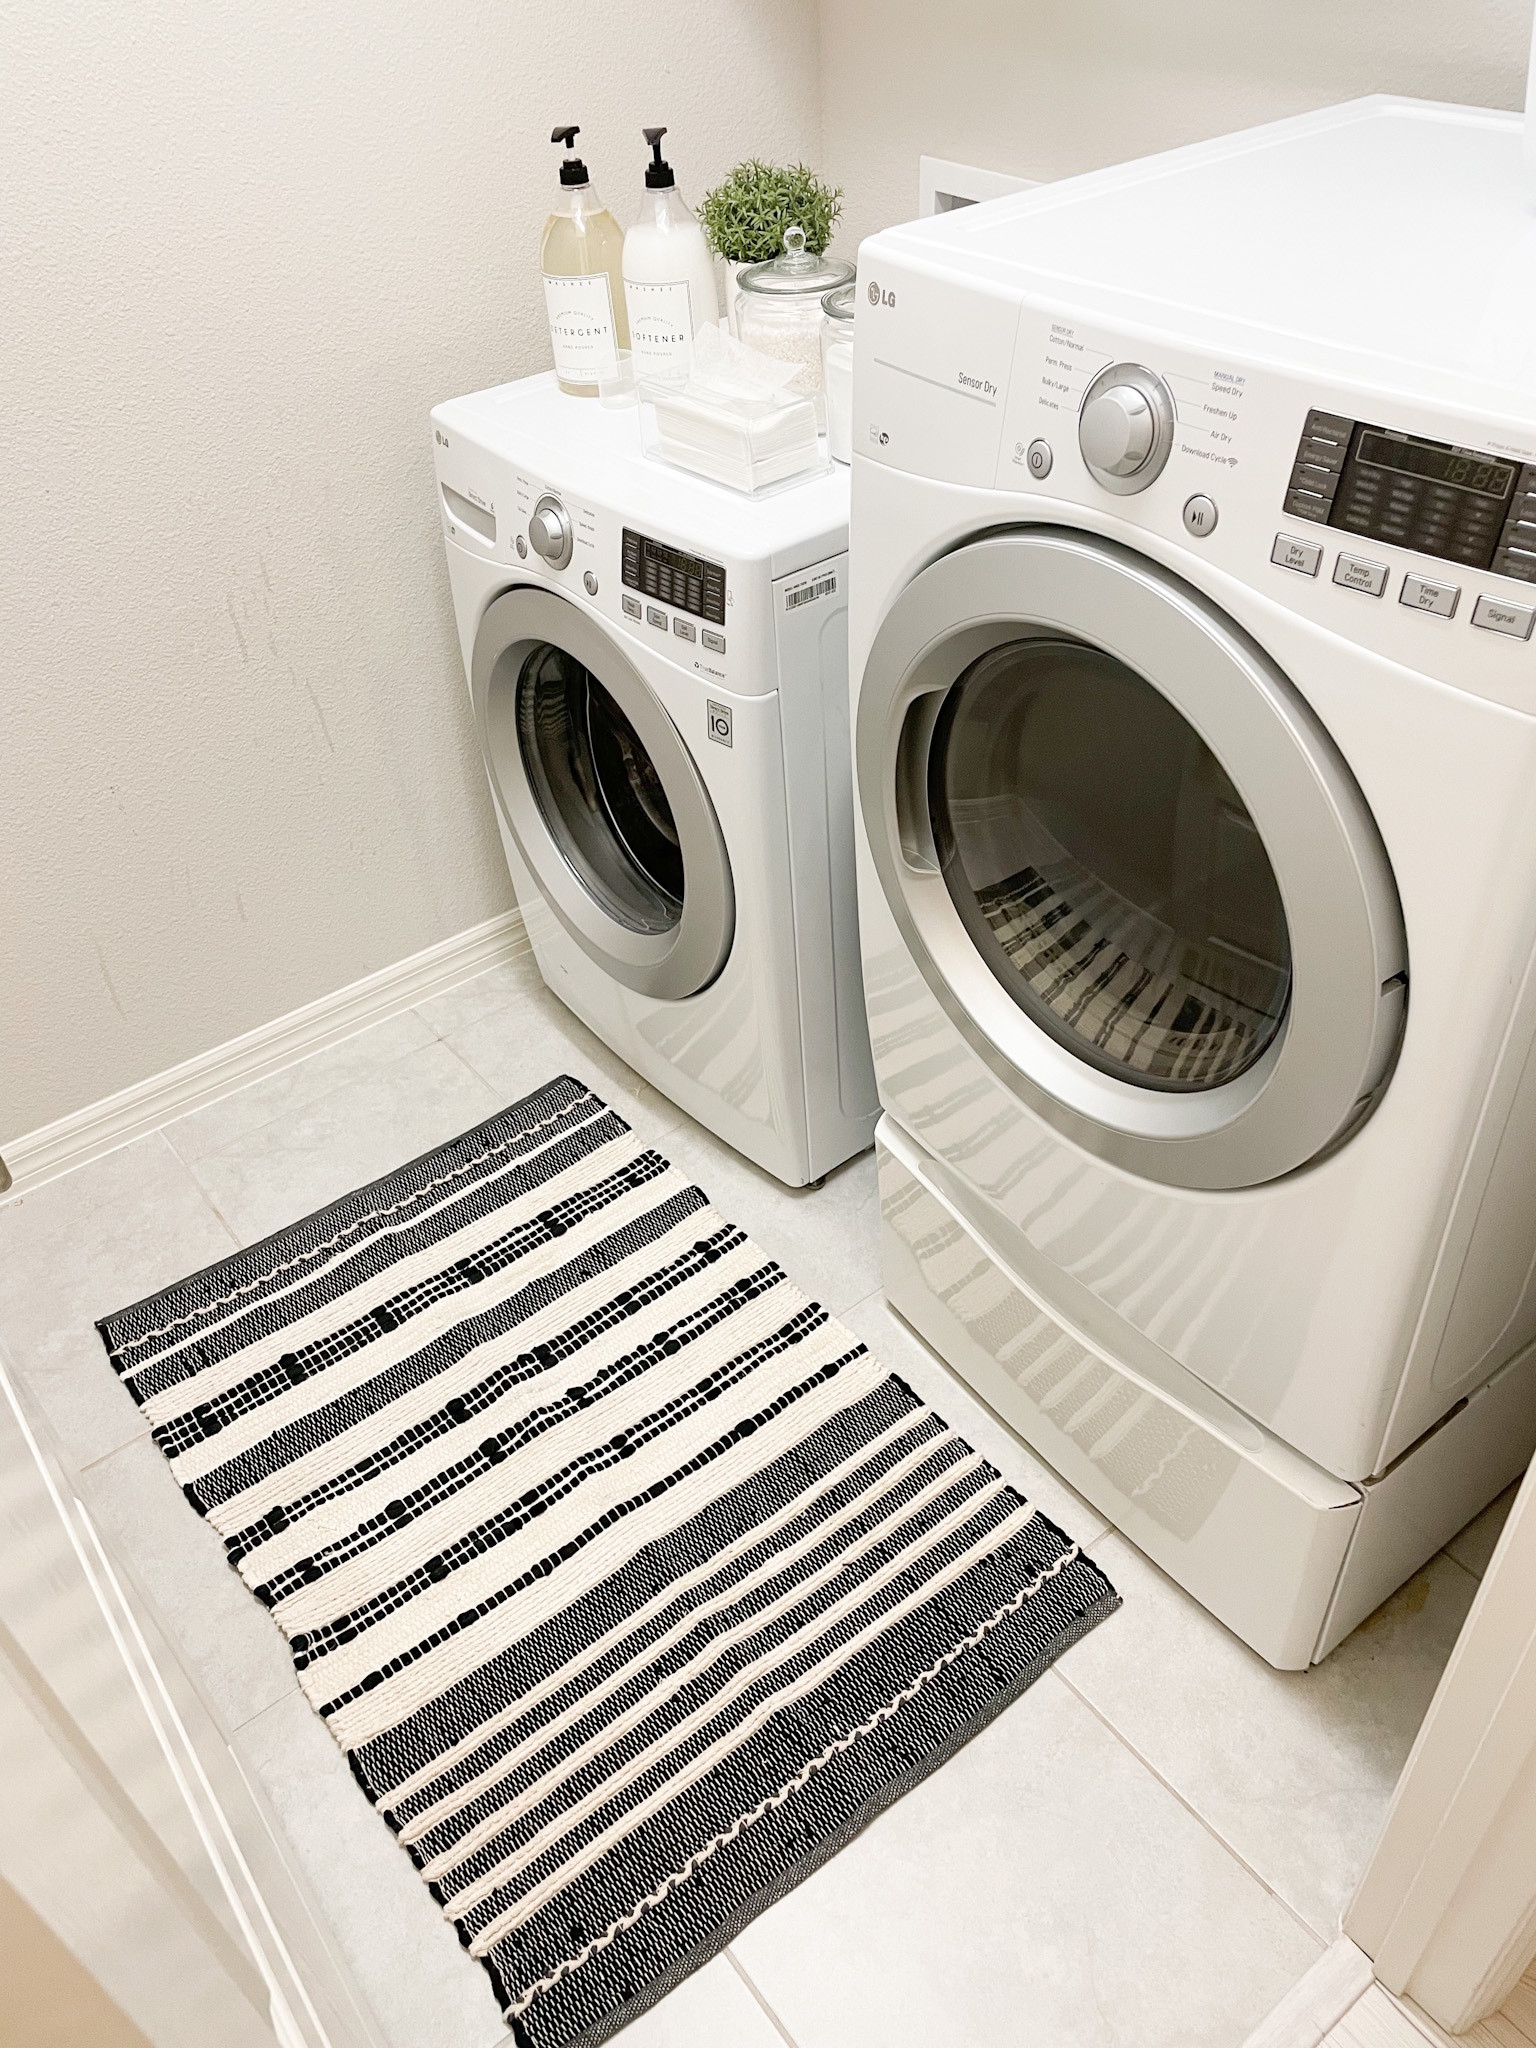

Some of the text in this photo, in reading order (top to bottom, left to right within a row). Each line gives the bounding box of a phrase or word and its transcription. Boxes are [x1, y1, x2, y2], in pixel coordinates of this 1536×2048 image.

[1049, 334, 1085, 352] Cotton/Normal
[1059, 361, 1073, 371] Press
[958, 371, 998, 397] Sensor Dry
[1041, 376, 1070, 393] Bulky/Large
[1211, 382, 1244, 398] Speed Dry
[1038, 396, 1059, 410] Delicates
[1203, 404, 1238, 421] Freshen Up
[1210, 430, 1232, 444] Air Dry
[1181, 444, 1227, 465] Download Cycle
[1291, 546, 1304, 558] Dry
[1285, 554, 1305, 567] Level
[1349, 563, 1370, 578] Temp
[1344, 573, 1373, 588] Control
[1420, 585, 1439, 598] Time
[1419, 596, 1434, 608] Dry
[1488, 609, 1517, 624] Signal
[711, 715, 729, 736] 10
